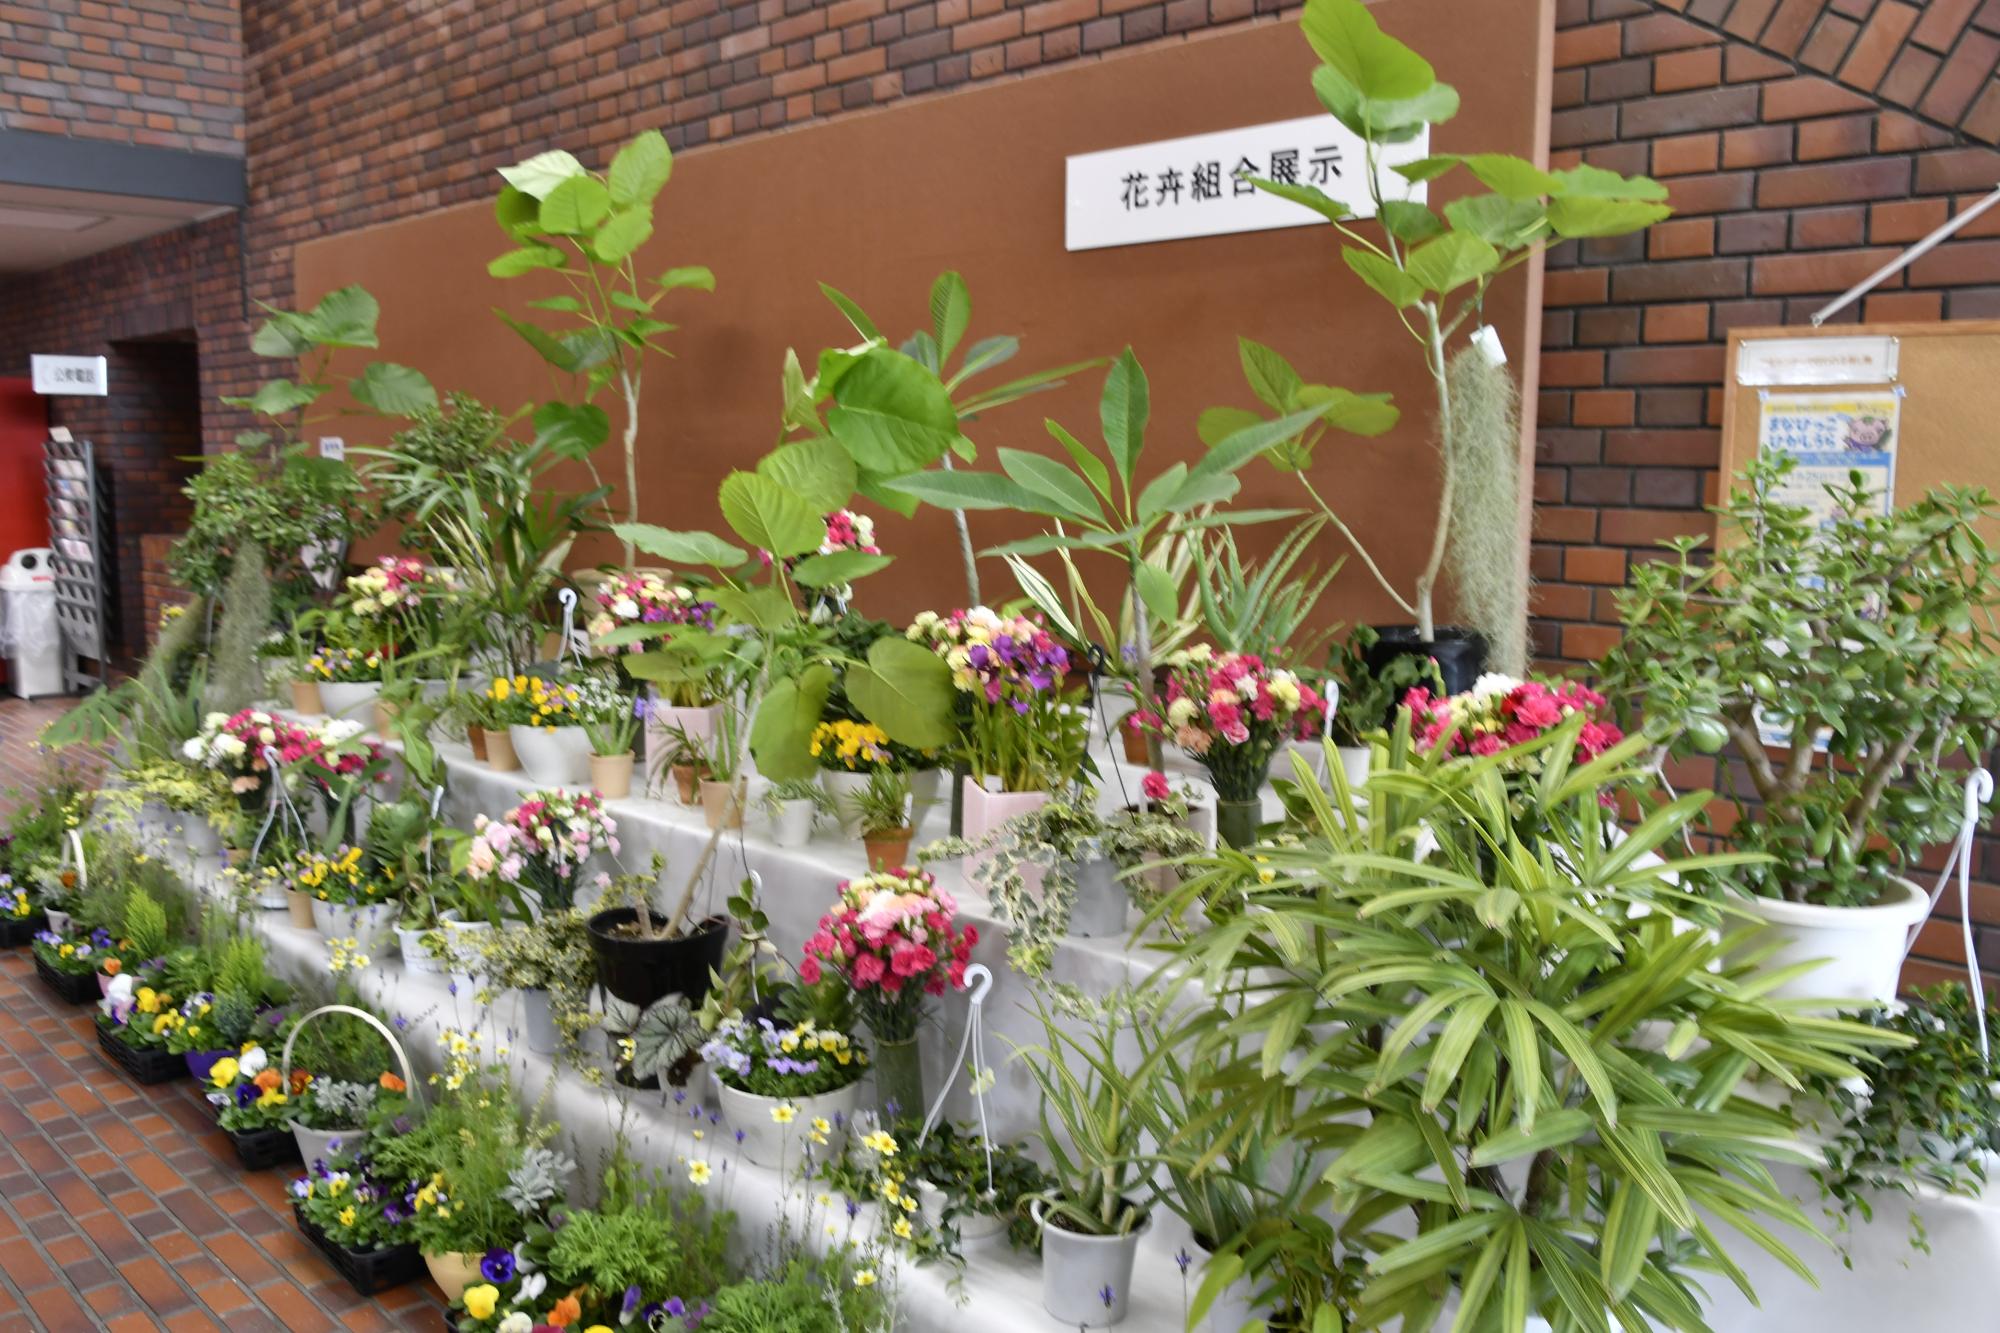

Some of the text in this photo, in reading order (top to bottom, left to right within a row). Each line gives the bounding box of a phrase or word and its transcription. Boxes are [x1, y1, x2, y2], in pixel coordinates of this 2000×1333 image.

[1120, 146, 1343, 211] 花卉組合展示
